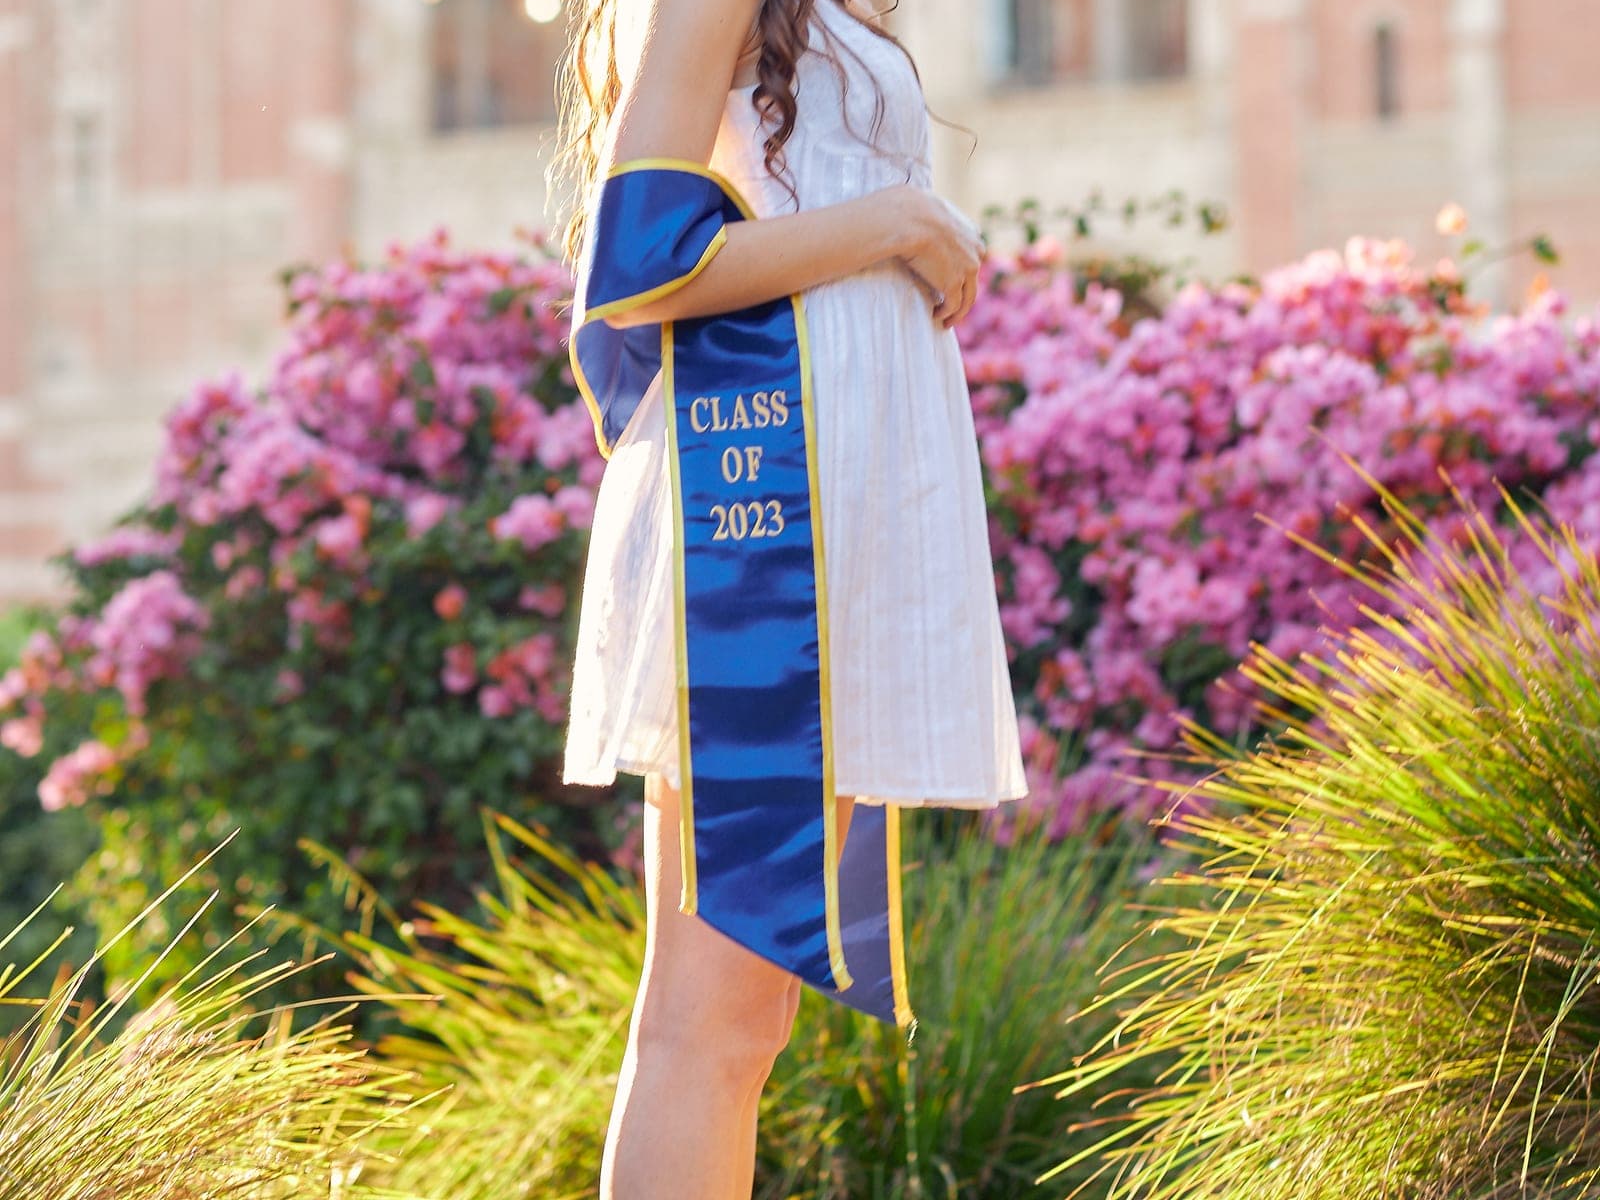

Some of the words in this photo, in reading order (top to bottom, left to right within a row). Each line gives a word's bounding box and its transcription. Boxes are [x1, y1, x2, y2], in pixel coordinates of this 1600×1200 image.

[690, 390, 789, 433] CLASS
[721, 446, 763, 483] OF
[709, 500, 785, 541] 2023
